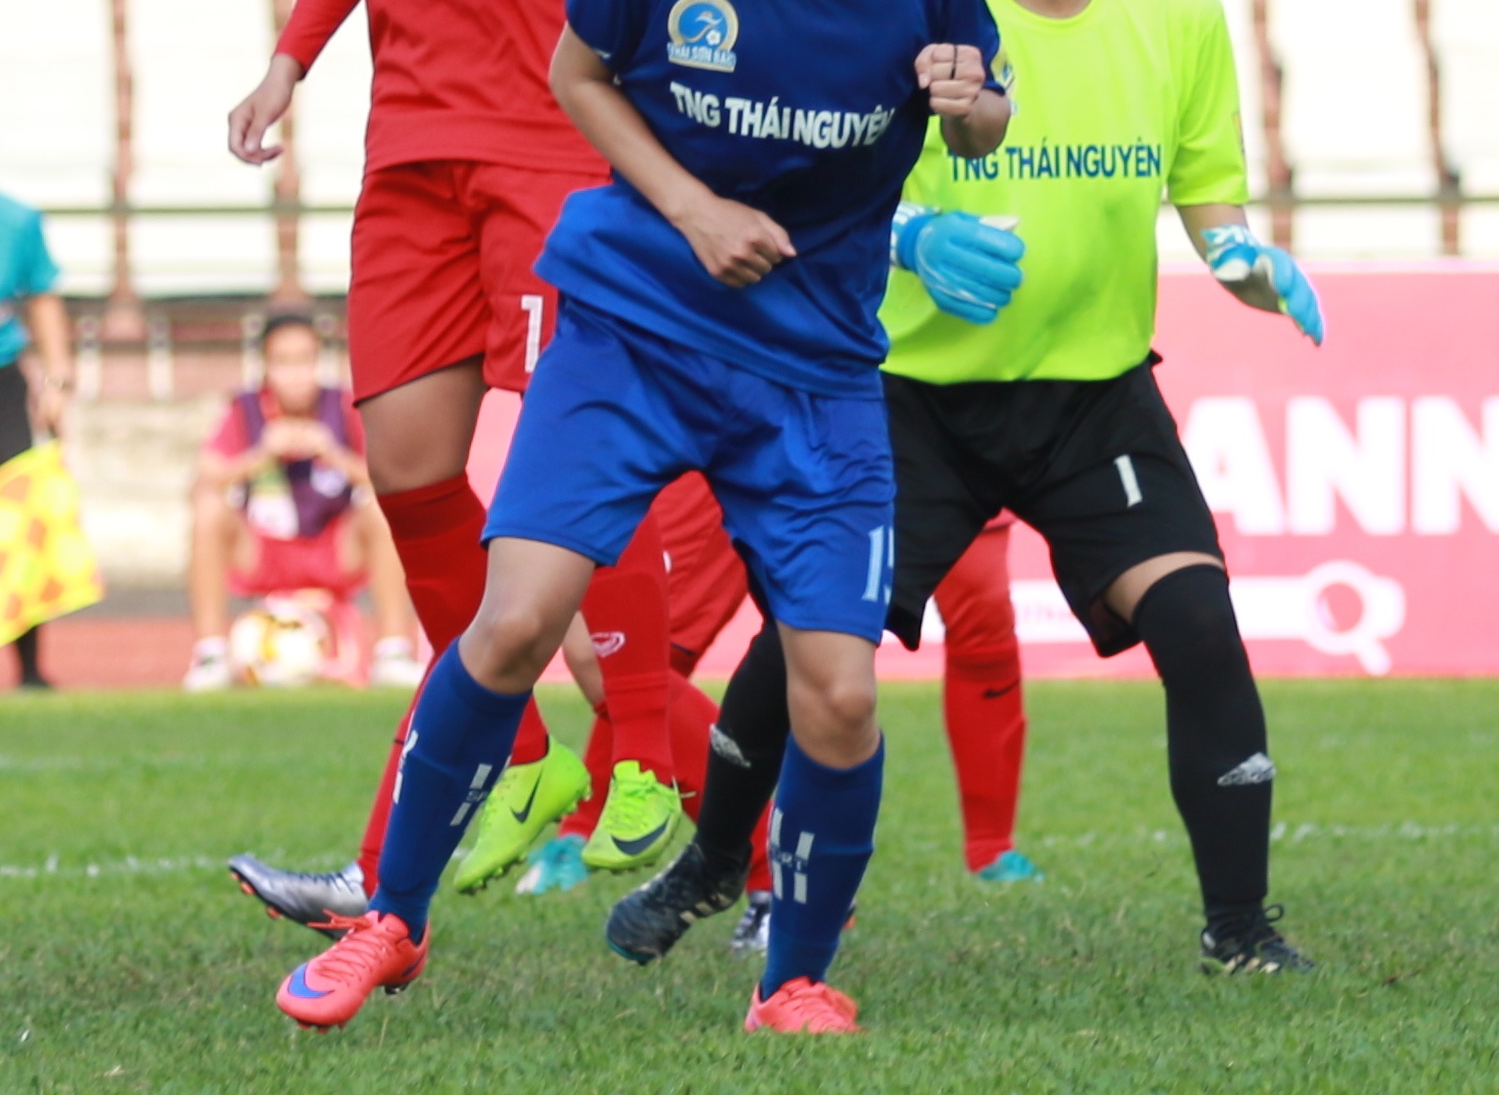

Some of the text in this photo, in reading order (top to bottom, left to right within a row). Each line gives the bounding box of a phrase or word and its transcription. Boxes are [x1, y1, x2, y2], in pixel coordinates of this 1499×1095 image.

[669, 81, 721, 128] TNG
[724, 95, 792, 140] THÁI
[1005, 136, 1061, 179] THÁI
[1066, 138, 1162, 179] NGUYÊN
[1114, 454, 1143, 508] 1
